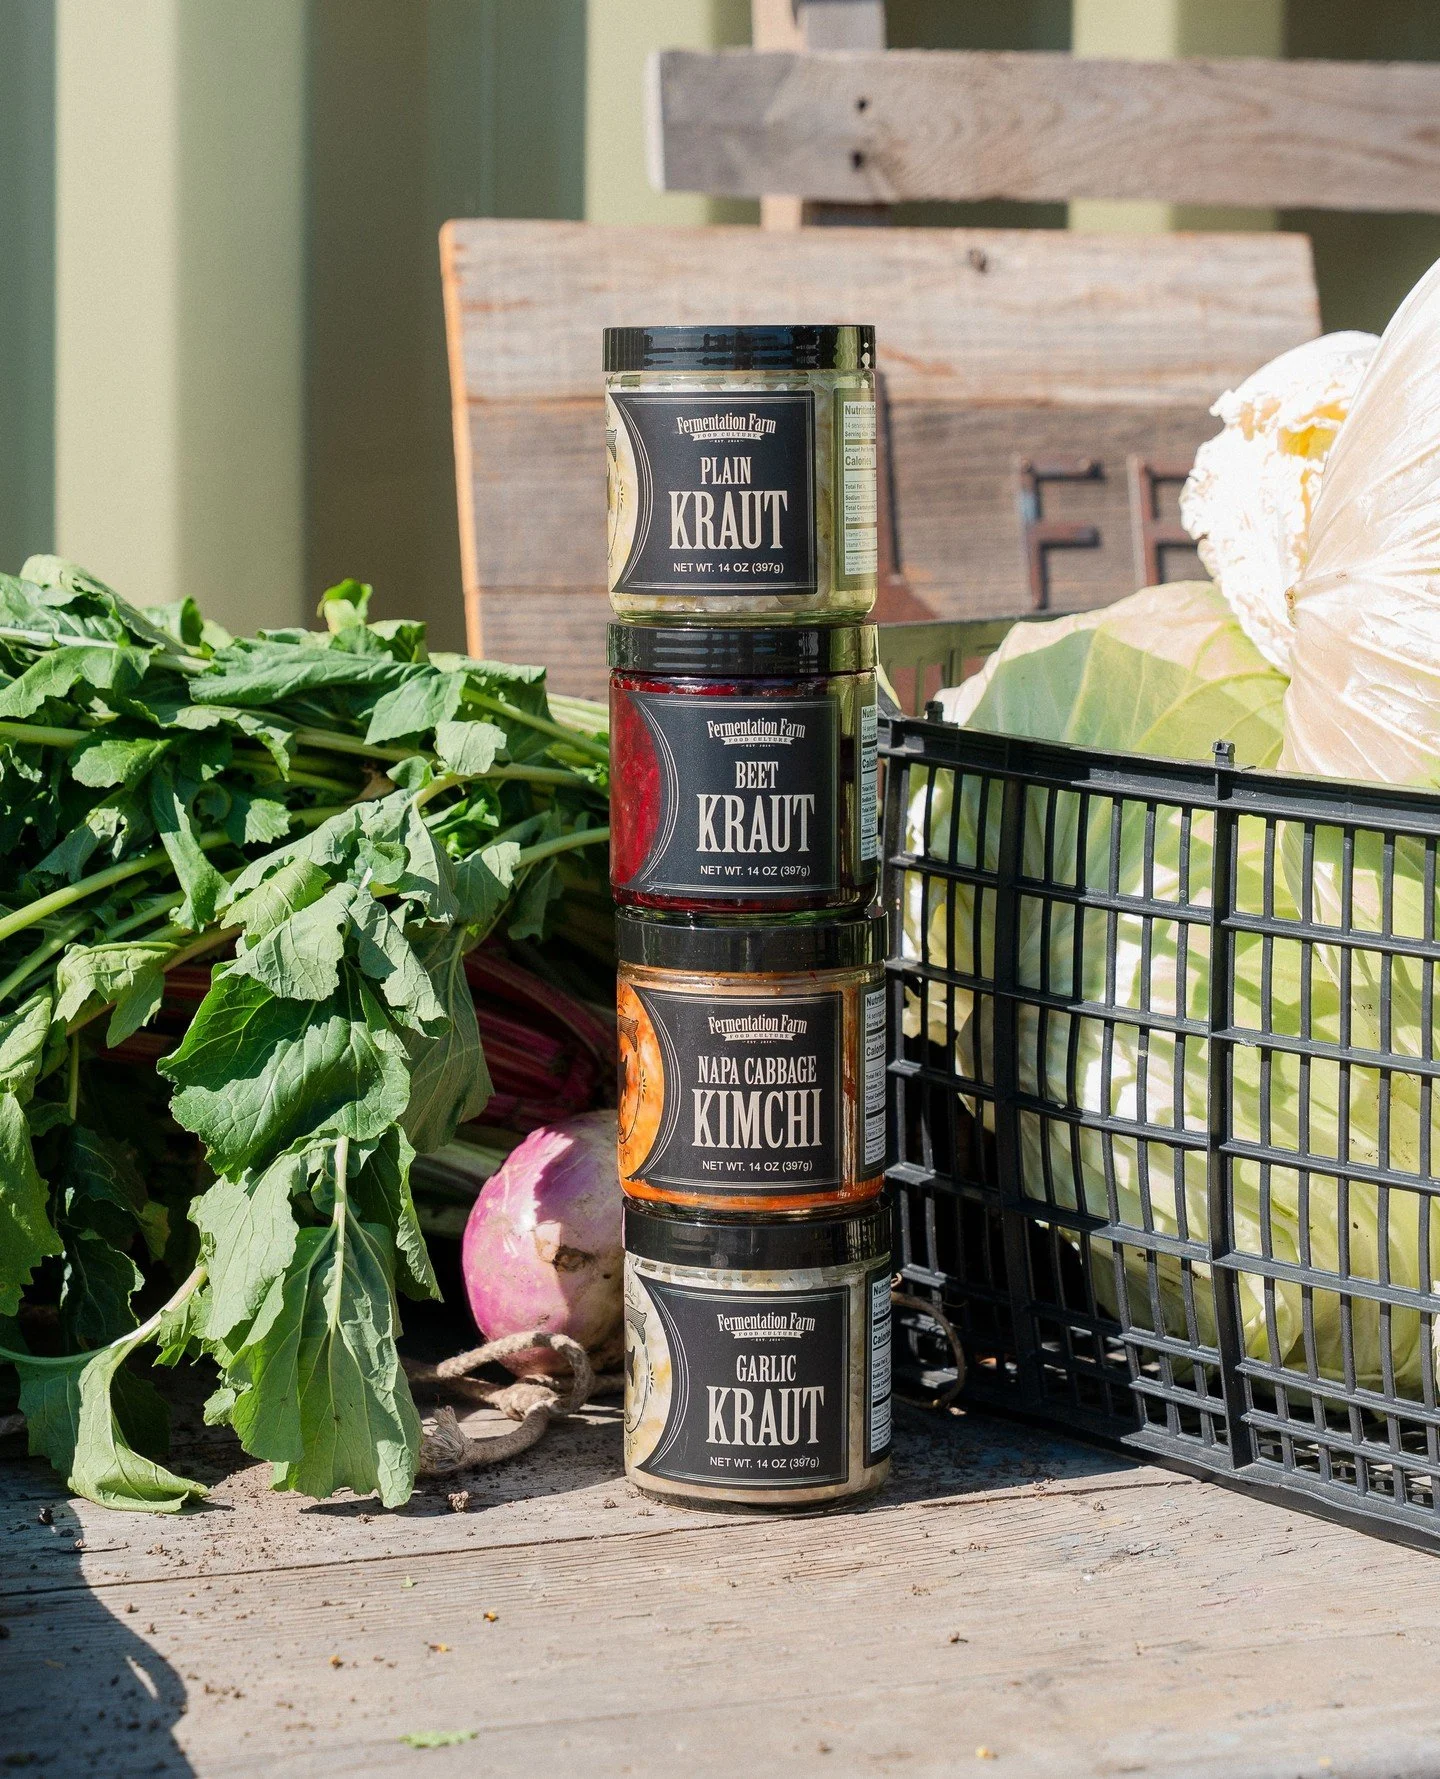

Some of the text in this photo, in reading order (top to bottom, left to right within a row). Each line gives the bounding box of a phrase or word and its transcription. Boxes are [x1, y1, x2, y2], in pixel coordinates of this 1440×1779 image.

[676, 412, 776, 435] Fermentation Farm
[700, 456, 752, 485] PLAIN
[668, 490, 788, 550] KRAUT
[673, 562, 784, 574] NET WT. 14 OZ (397g)
[706, 717, 806, 739] Fermentation Farm
[734, 761, 779, 789] BEET
[696, 794, 815, 853] KRAUT
[700, 865, 811, 877] NET WT. 14 OZ (397g)
[707, 1014, 808, 1035] Fermentation Farm
[698, 1055, 817, 1085] NAPA CABBAGE
[692, 1088, 823, 1149] KIMCHI
[702, 1160, 813, 1173] NET WT. 14 OZ (397g)
[716, 1311, 816, 1332] Fermentation Farm
[736, 1354, 797, 1383] GARLIC
[706, 1385, 825, 1446] KRAUT
[709, 1457, 820, 1469] NET WT. 14 OZ (397g)
